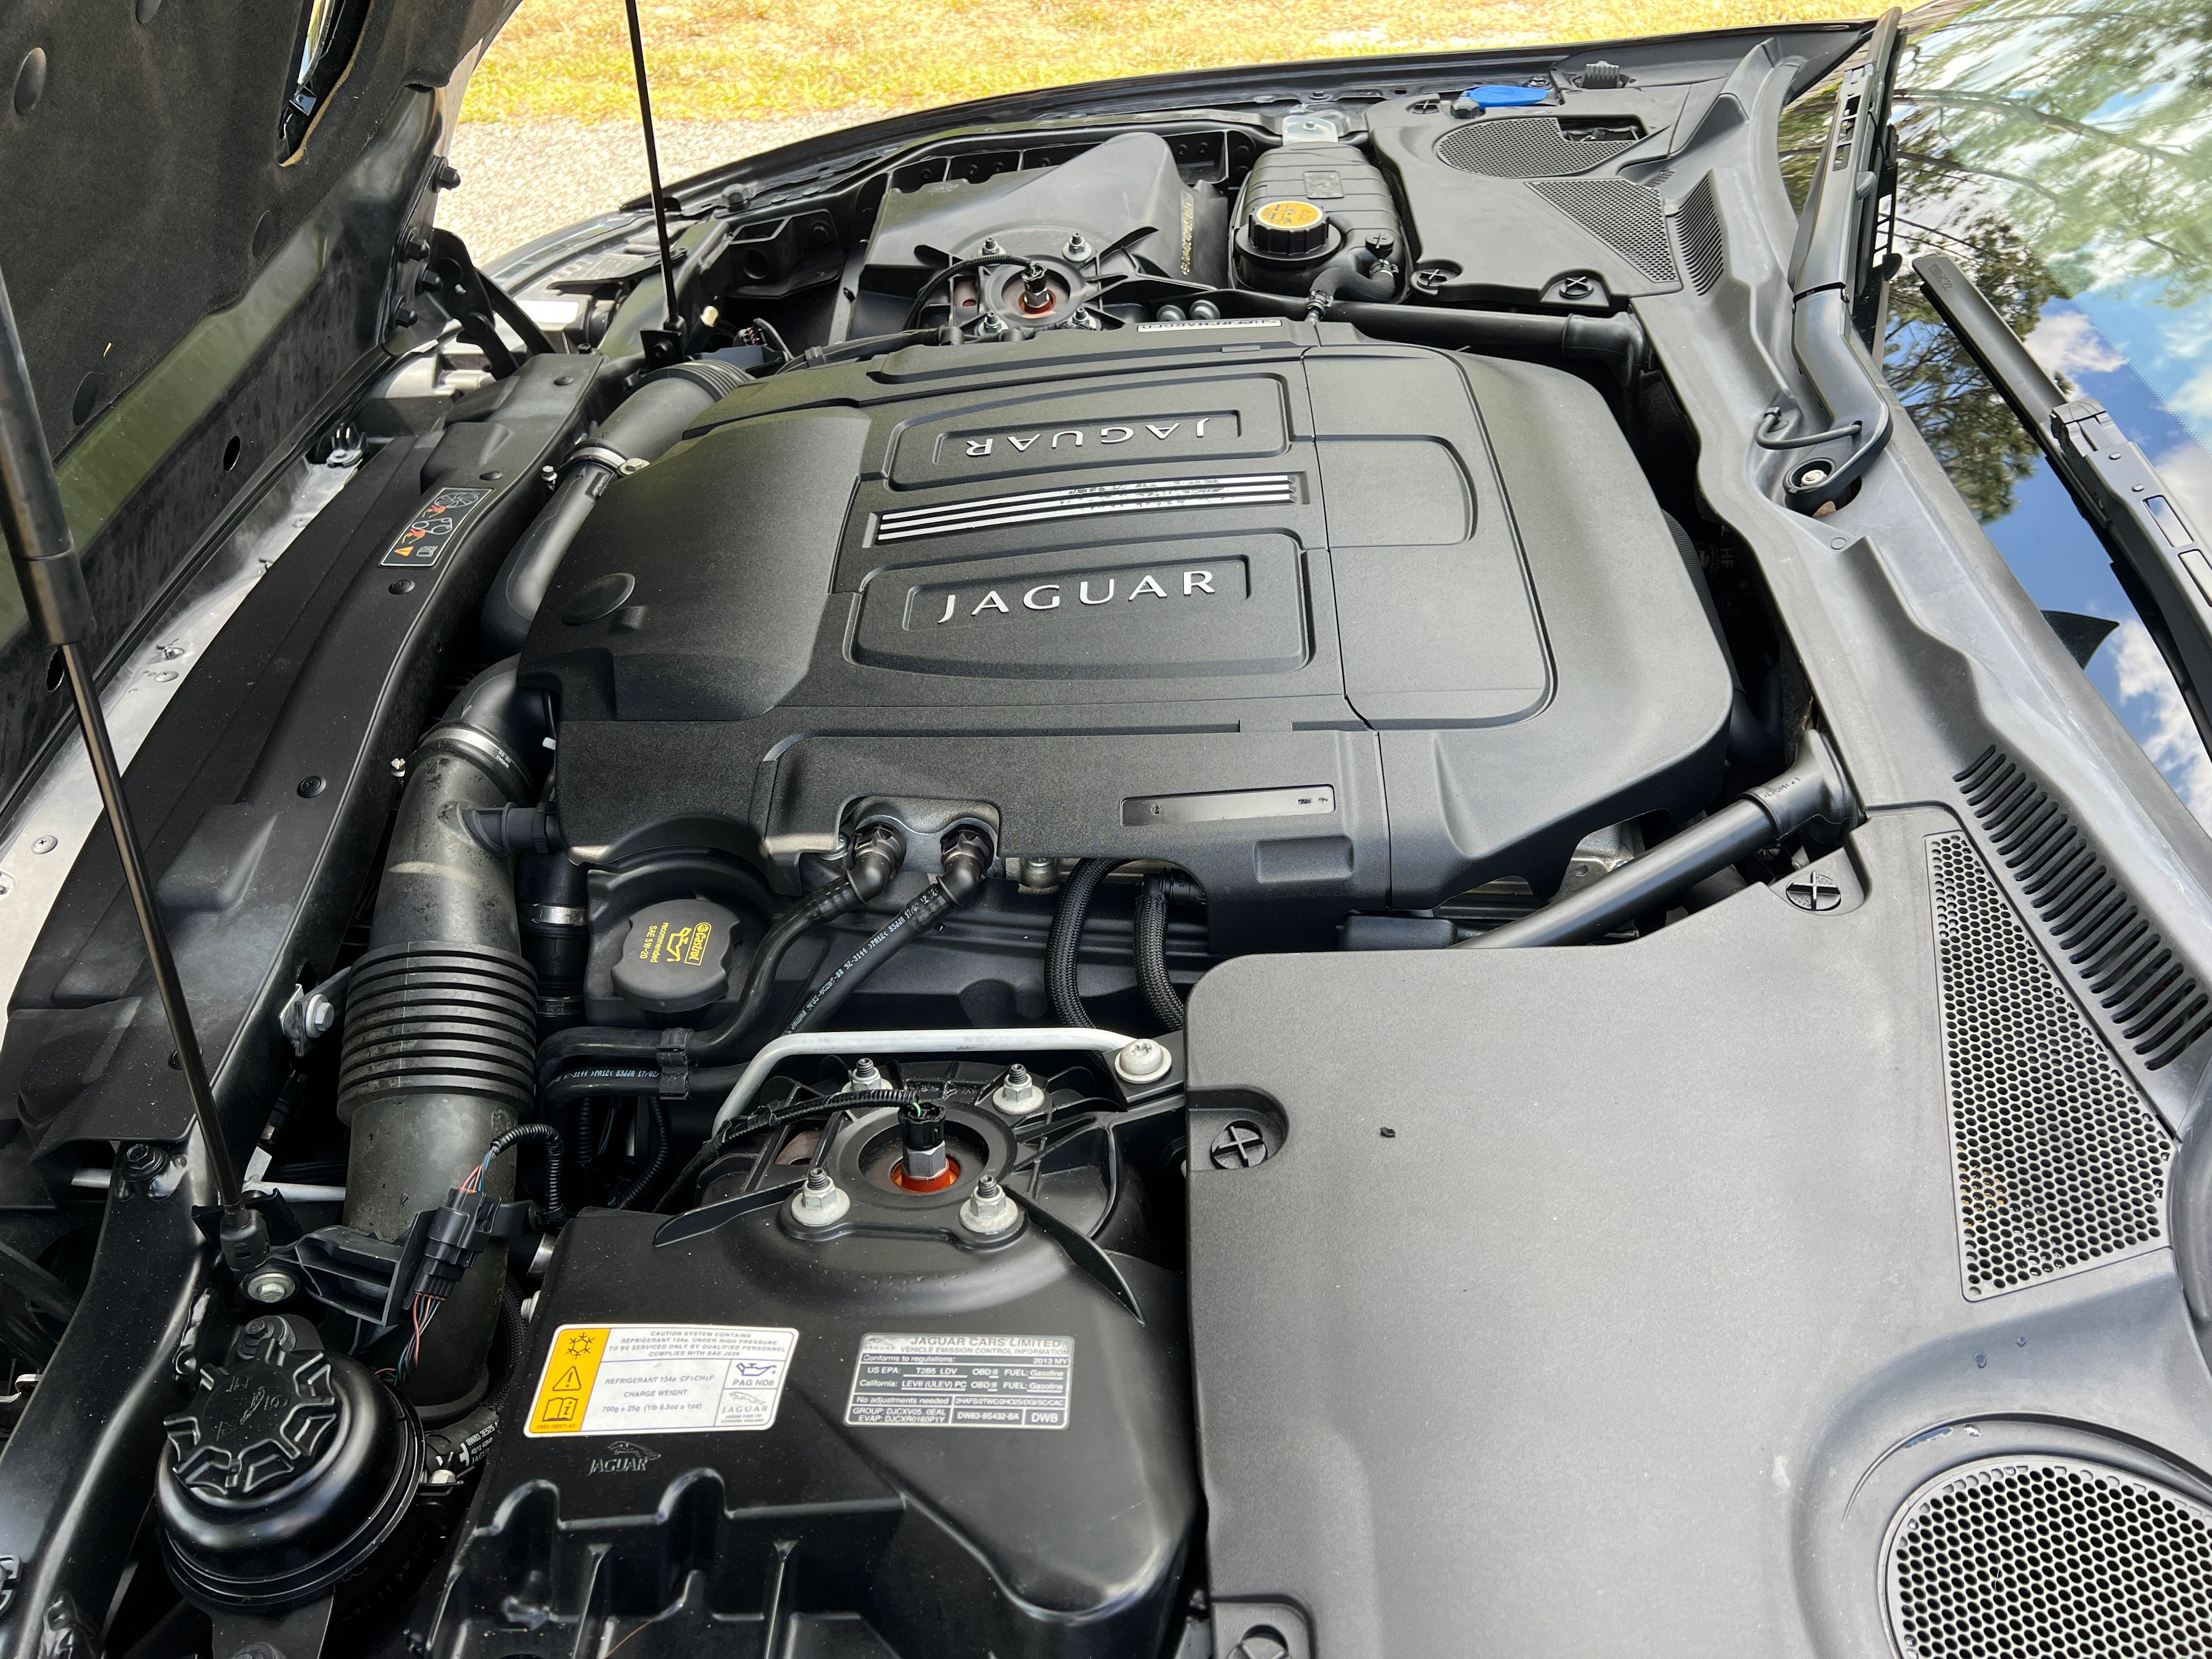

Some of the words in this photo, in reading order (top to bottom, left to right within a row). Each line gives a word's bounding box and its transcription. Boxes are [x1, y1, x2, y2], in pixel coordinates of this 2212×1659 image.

[965, 417, 1210, 457] JAGUAR
[937, 569, 1216, 624] JAGUAR
[647, 925, 658, 938] SAE
[640, 938, 653, 959] 5W-20
[650, 922, 669, 963] recommended
[689, 932, 707, 961] Castrol
[969, 1338, 1005, 1346] CARS
[1010, 1339, 1060, 1347] LIMITED
[924, 1380, 952, 1389] (ULEV)
[1003, 1381, 1028, 1390] FUEL:
[1029, 1382, 1063, 1390] Gasoline
[870, 1396, 917, 1404] adjustments
[722, 1406, 768, 1414] JAGUAR
[1031, 1413, 1058, 1423] DWB
[587, 1457, 647, 1476] JAGUAR
